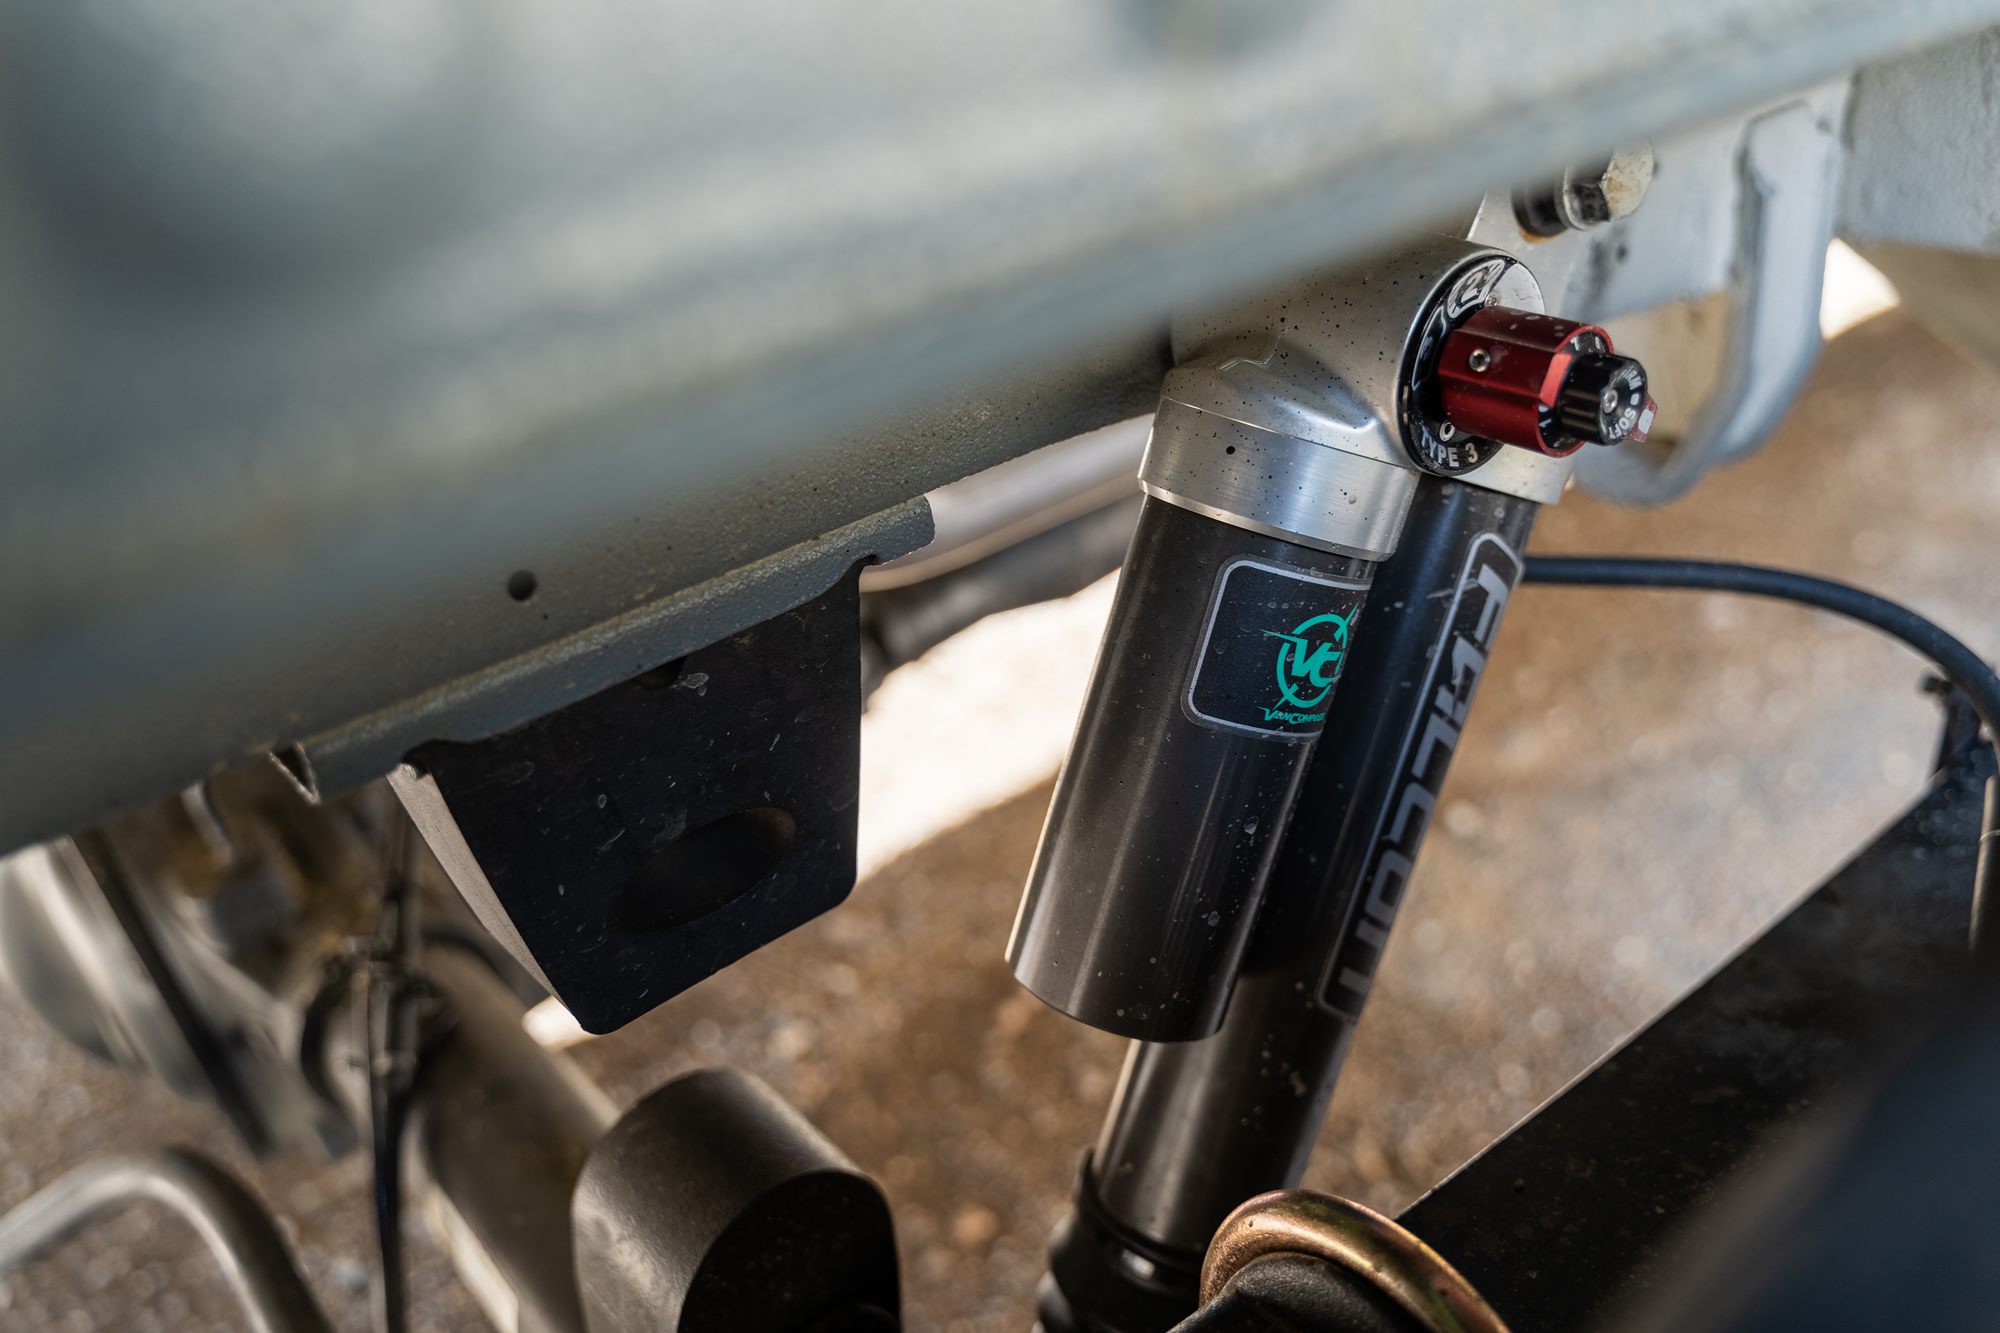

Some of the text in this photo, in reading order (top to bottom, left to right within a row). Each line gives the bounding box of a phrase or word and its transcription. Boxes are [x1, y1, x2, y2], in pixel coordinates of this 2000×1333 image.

[1607, 407, 1636, 439] SOFT
[1421, 425, 1478, 467] TYPE 3
[1338, 563, 1510, 996] FALCON
